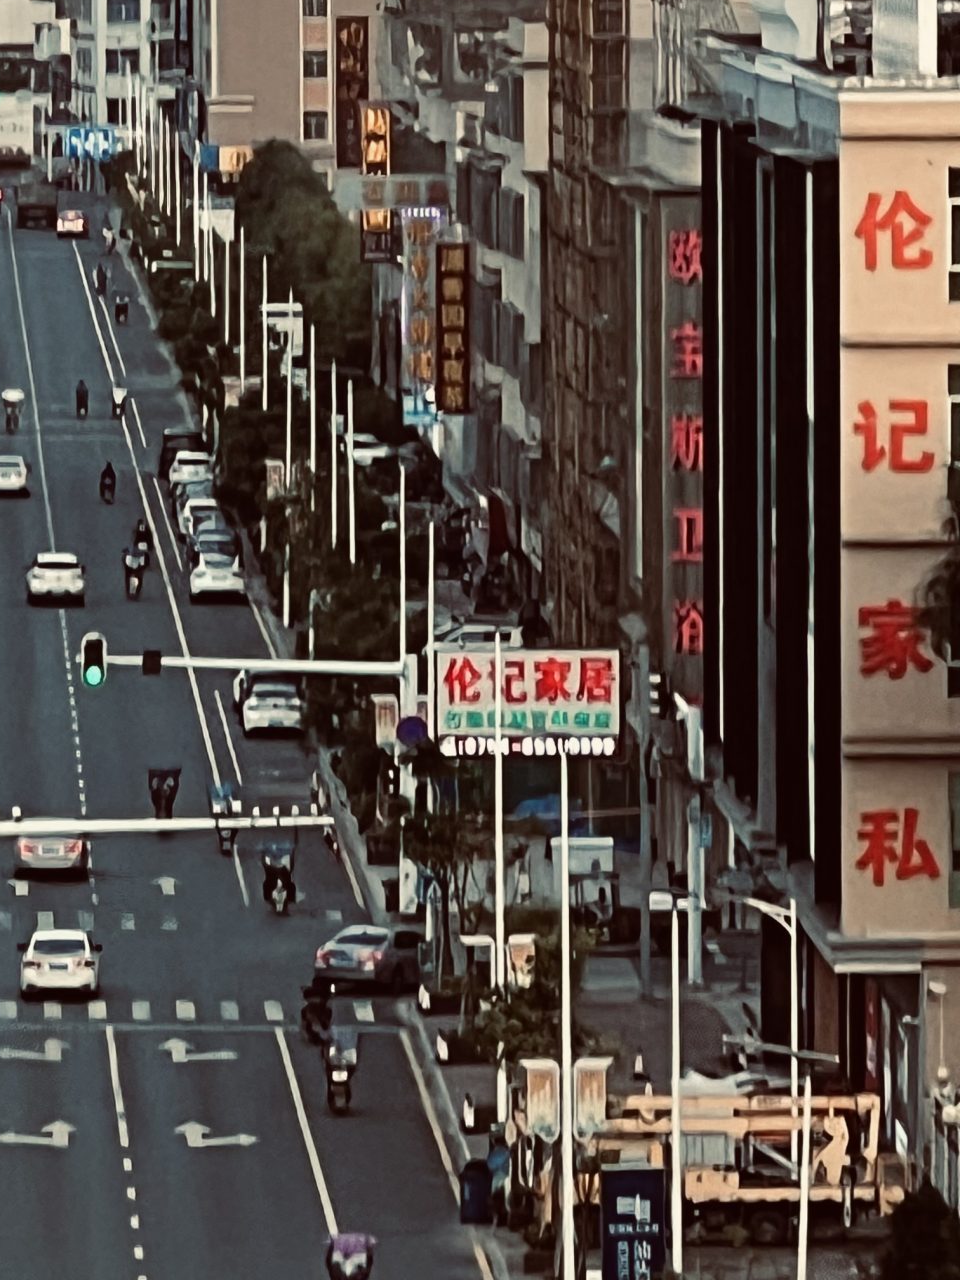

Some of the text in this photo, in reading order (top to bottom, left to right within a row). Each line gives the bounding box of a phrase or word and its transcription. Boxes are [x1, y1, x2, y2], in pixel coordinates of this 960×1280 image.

[443, 656, 615, 705] 伦记家居
[854, 190, 940, 887] 伦记家私
